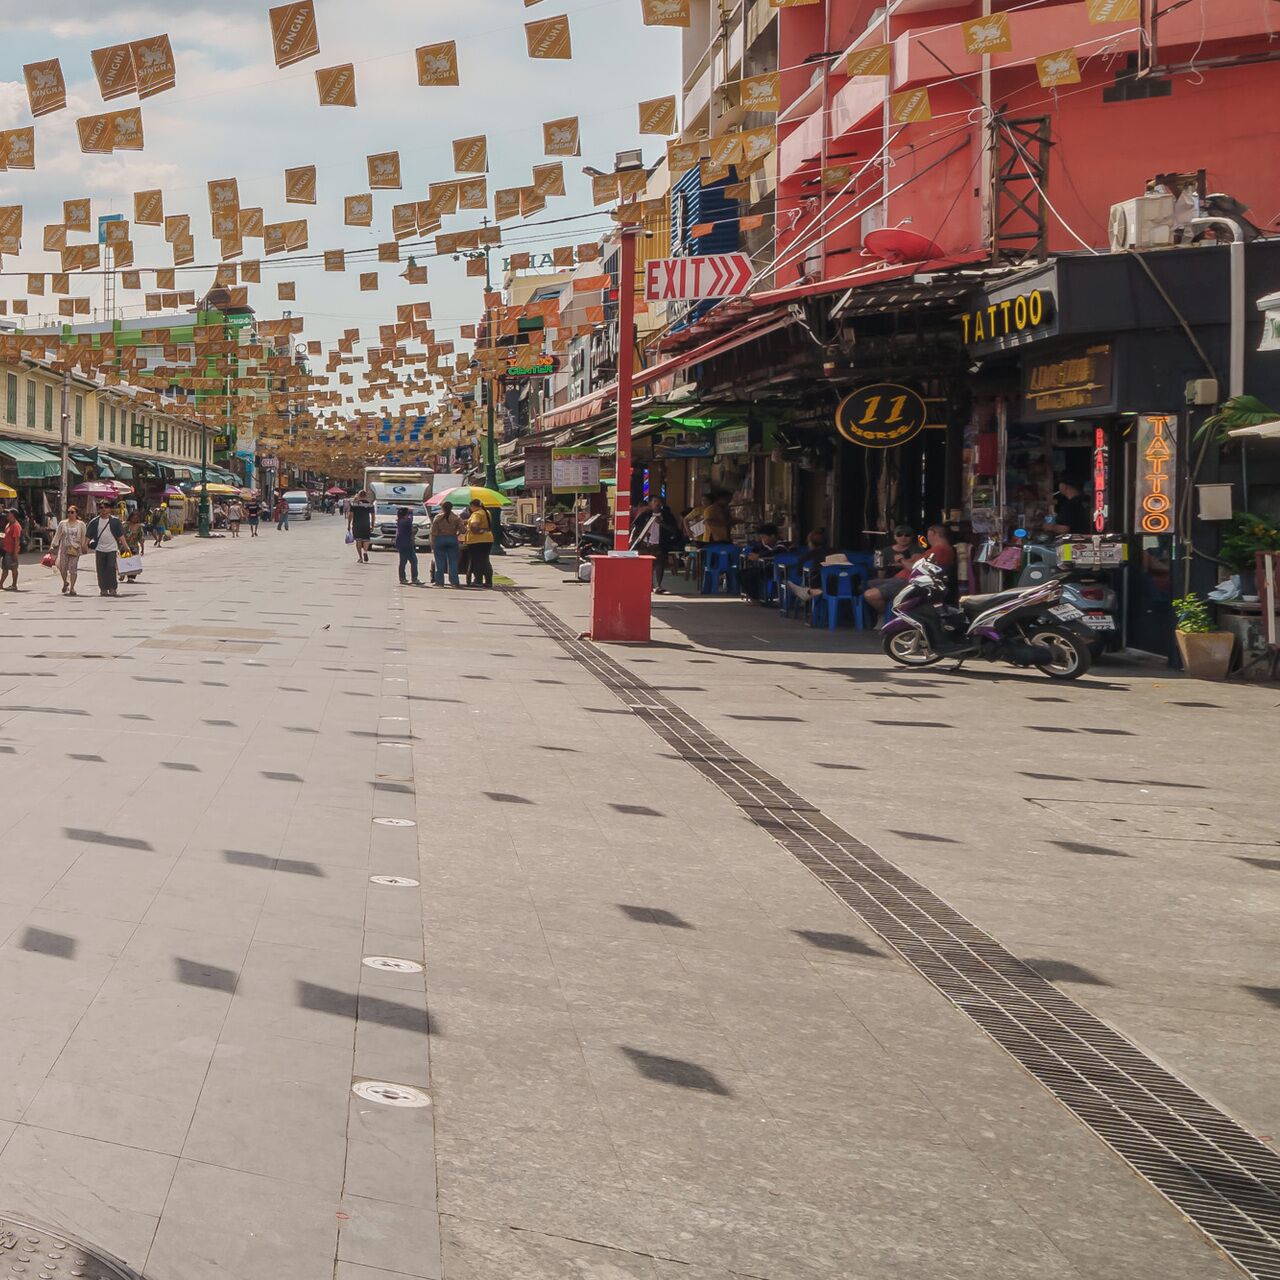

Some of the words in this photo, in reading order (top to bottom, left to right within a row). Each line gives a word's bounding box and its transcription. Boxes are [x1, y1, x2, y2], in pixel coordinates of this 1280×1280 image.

[279, 7, 309, 53] SINGHA
[534, 23, 565, 58] SINGHA
[968, 36, 1007, 52] SINGHA
[104, 50, 126, 86] SINGHA
[138, 64, 172, 76] SINGHA
[421, 69, 456, 81] SINGHA
[852, 46, 884, 75] SINGHA
[31, 86, 64, 98] SINGHA
[325, 70, 351, 103] SINGHA
[645, 101, 671, 131] SINGHA
[899, 91, 924, 121] SINGHA
[85, 117, 107, 149] SINGHA
[459, 141, 484, 171] SINGHA
[1, 209, 20, 235] SINGHA
[141, 194, 160, 221] SINGHA
[647, 258, 701, 301] EXIT
[962, 289, 1042, 345] TATTOO
[858, 395, 908, 424] 11
[1141, 415, 1170, 532] TATTOO
